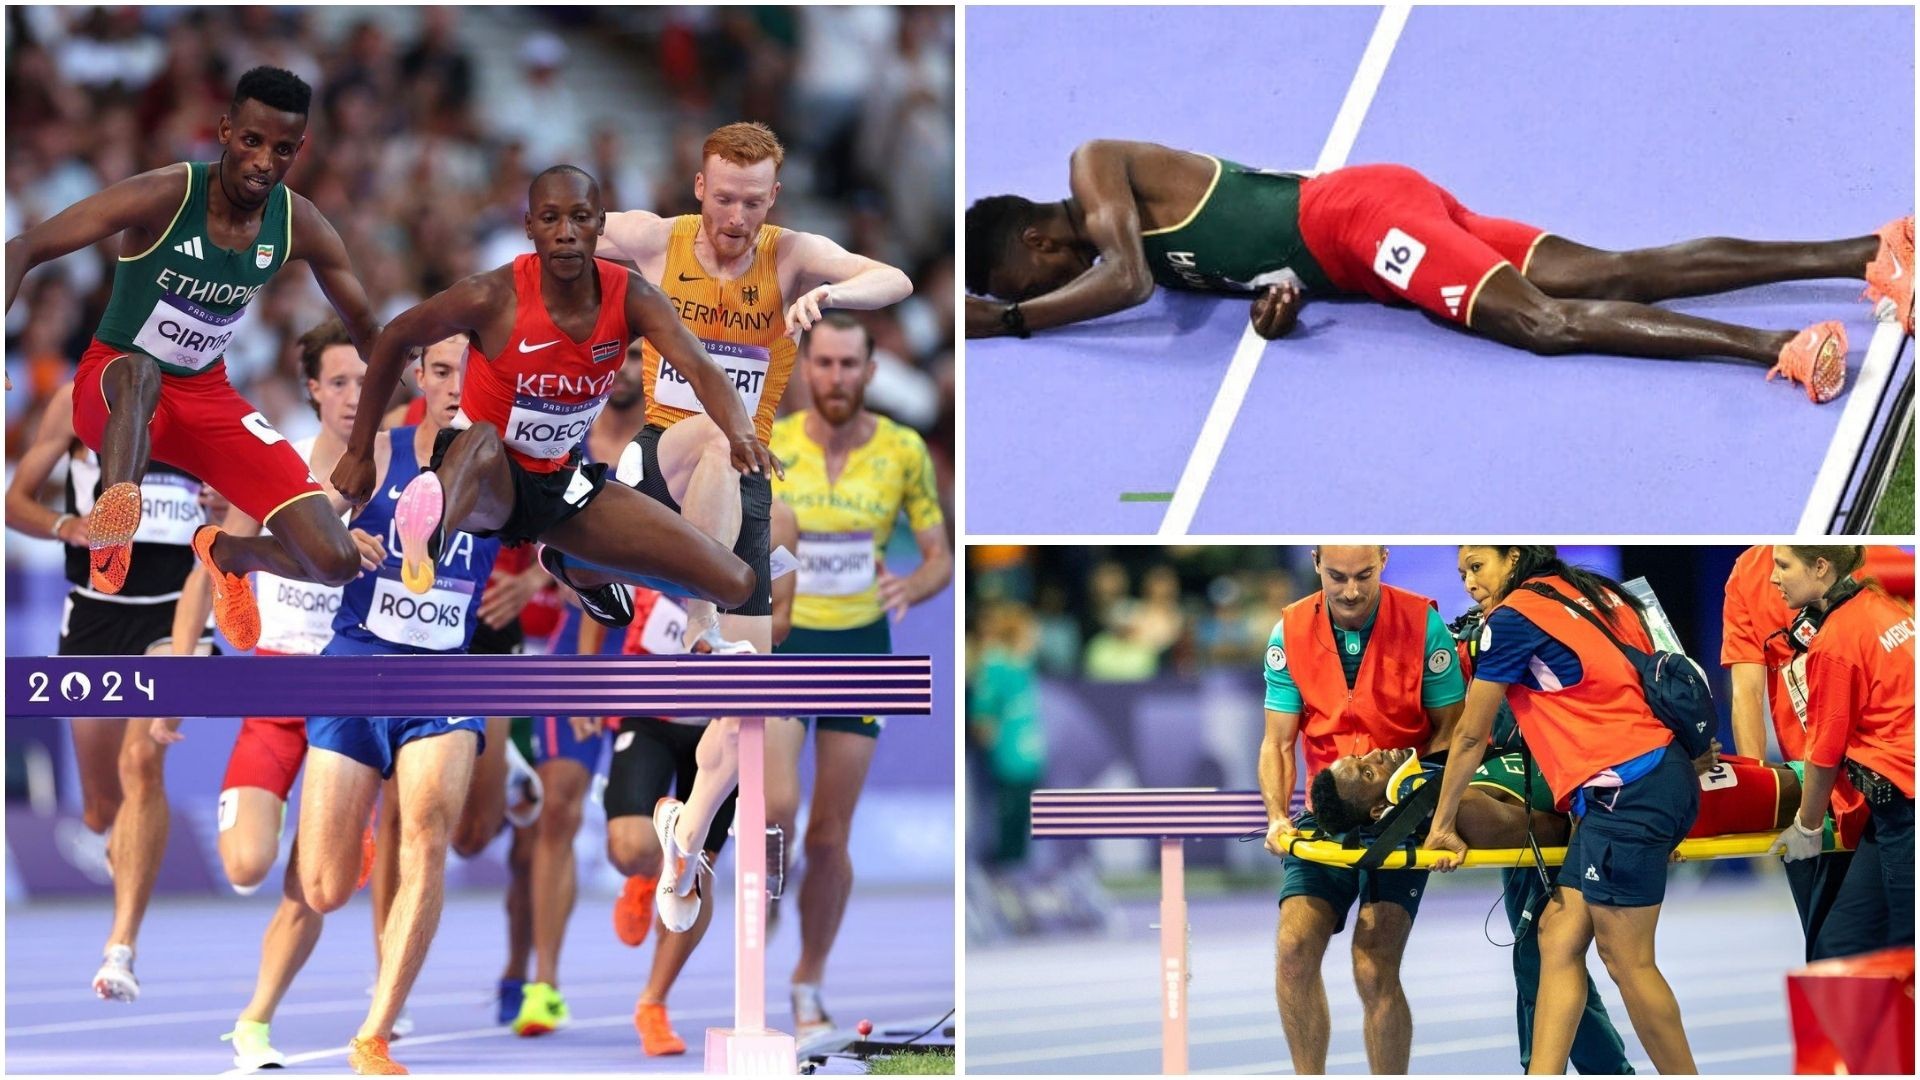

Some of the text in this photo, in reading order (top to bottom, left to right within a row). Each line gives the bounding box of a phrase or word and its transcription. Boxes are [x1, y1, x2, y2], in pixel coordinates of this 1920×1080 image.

[1384, 245, 1411, 275] 16
[670, 296, 775, 330] GERMANY
[157, 320, 233, 353] GIRMA
[516, 369, 615, 397] KENYA
[542, 402, 570, 413] PARIS
[387, 517, 474, 572] UA
[276, 583, 341, 614] DESGAC
[378, 592, 461, 628] ROOKS
[28, 671, 155, 702] 2024
